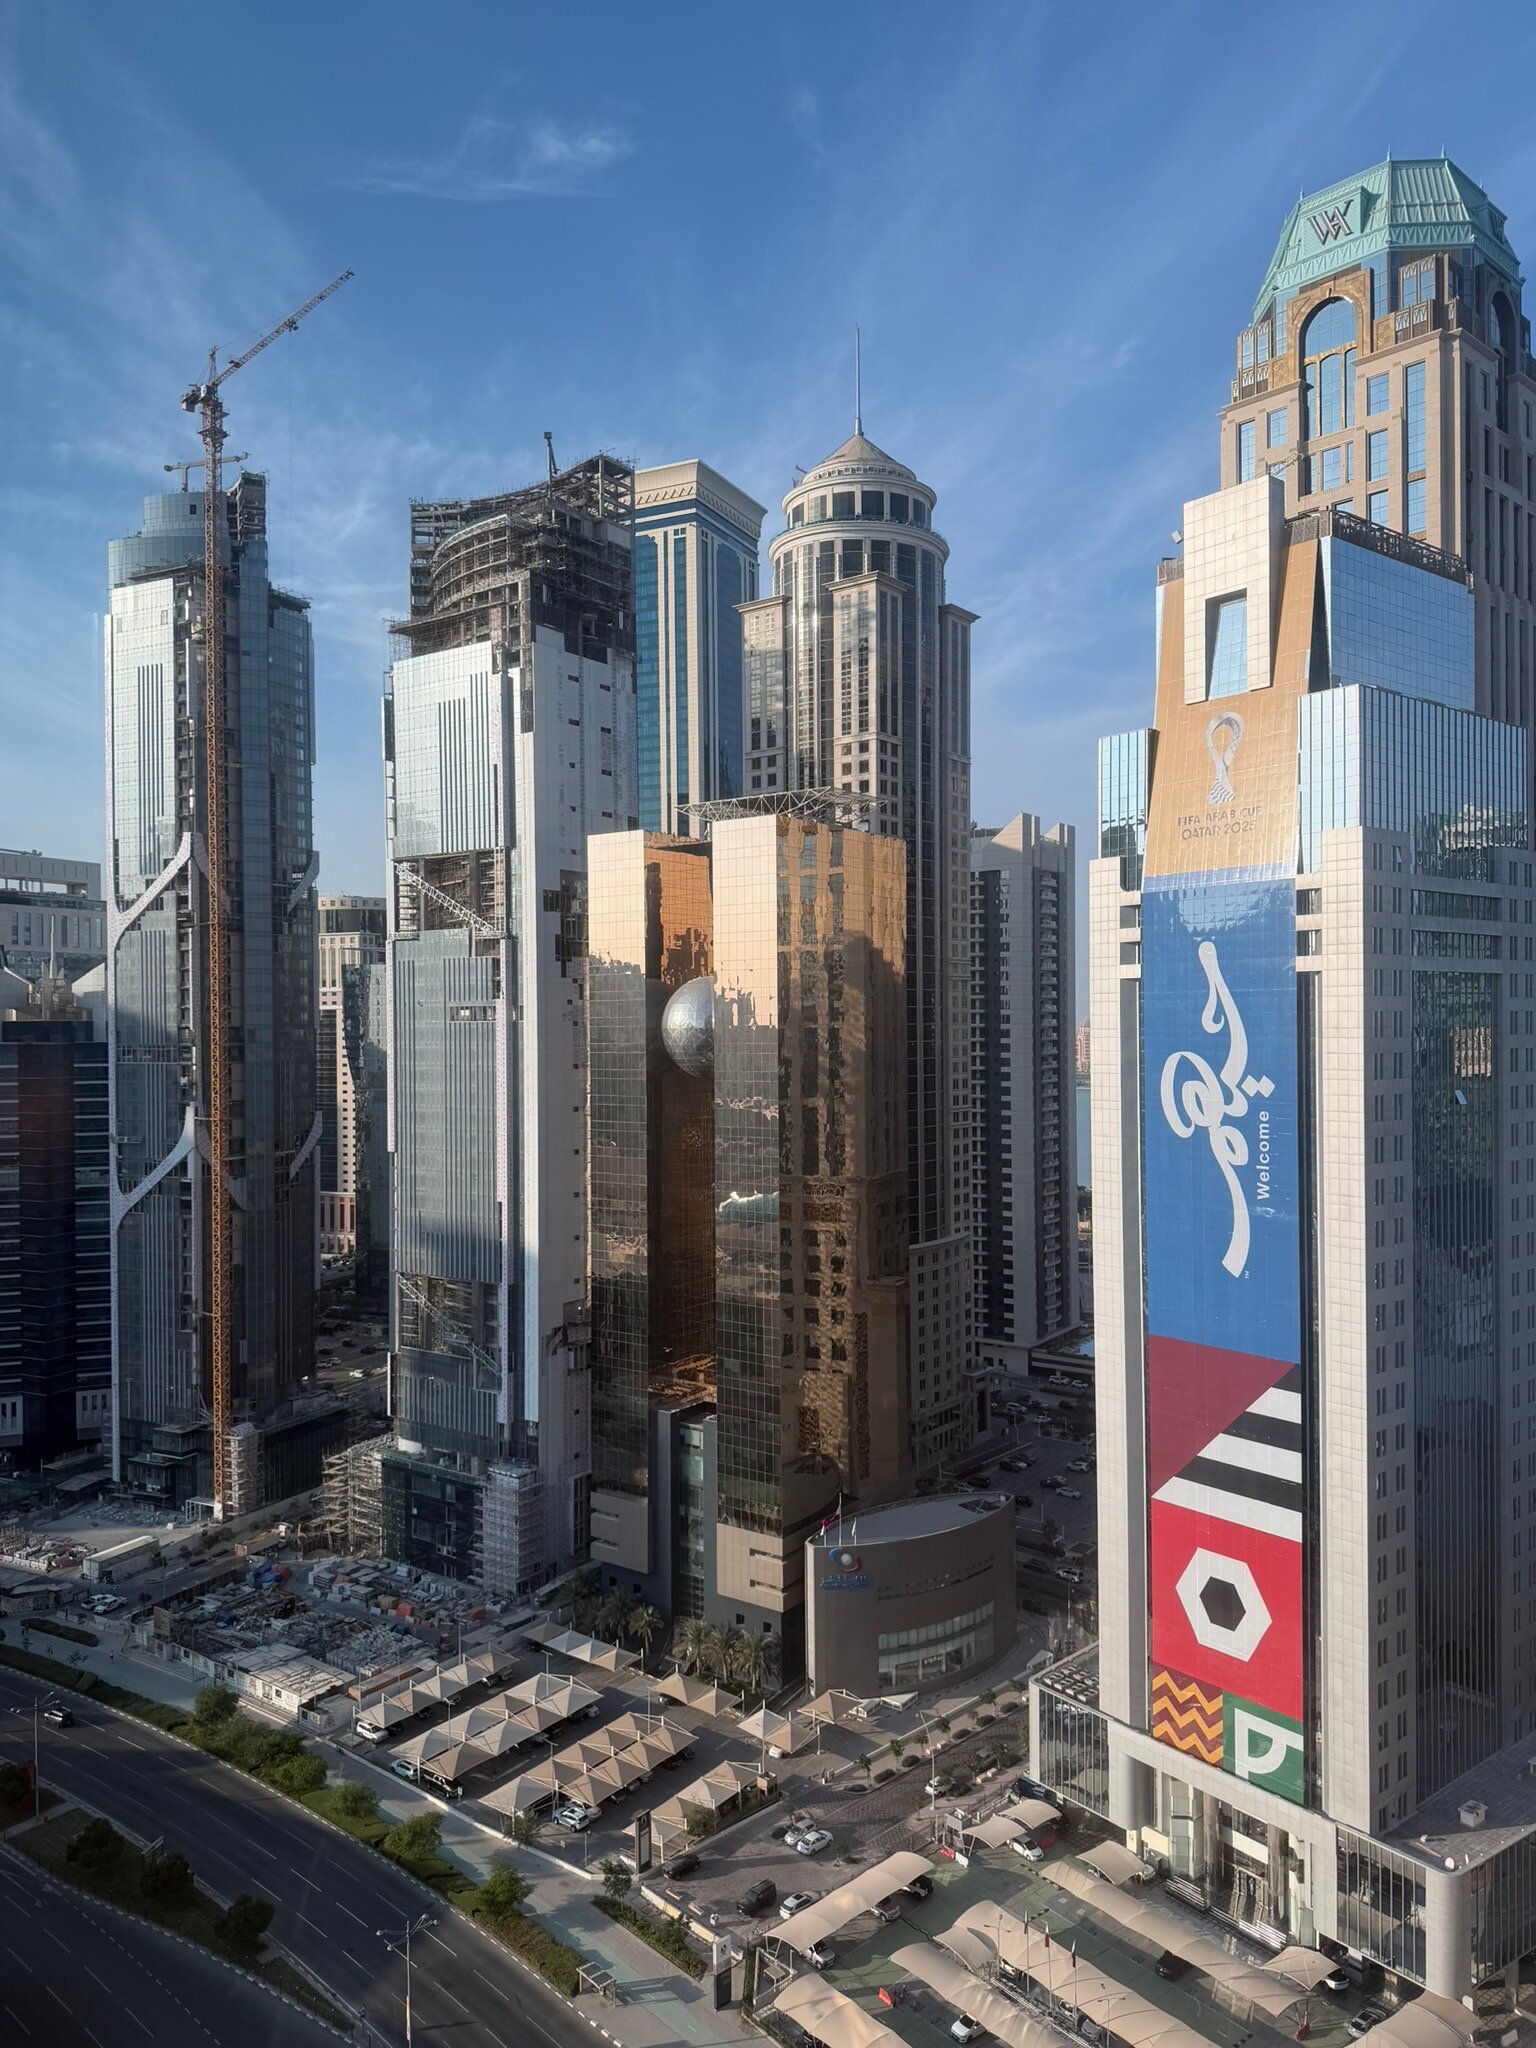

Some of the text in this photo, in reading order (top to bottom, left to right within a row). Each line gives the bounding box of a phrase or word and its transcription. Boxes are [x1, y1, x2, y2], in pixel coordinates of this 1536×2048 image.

[1178, 805, 1264, 827] FIFA ARAB CUP
[1181, 824, 1221, 841] QATAR
[1256, 1110, 1270, 1200] Welcome
